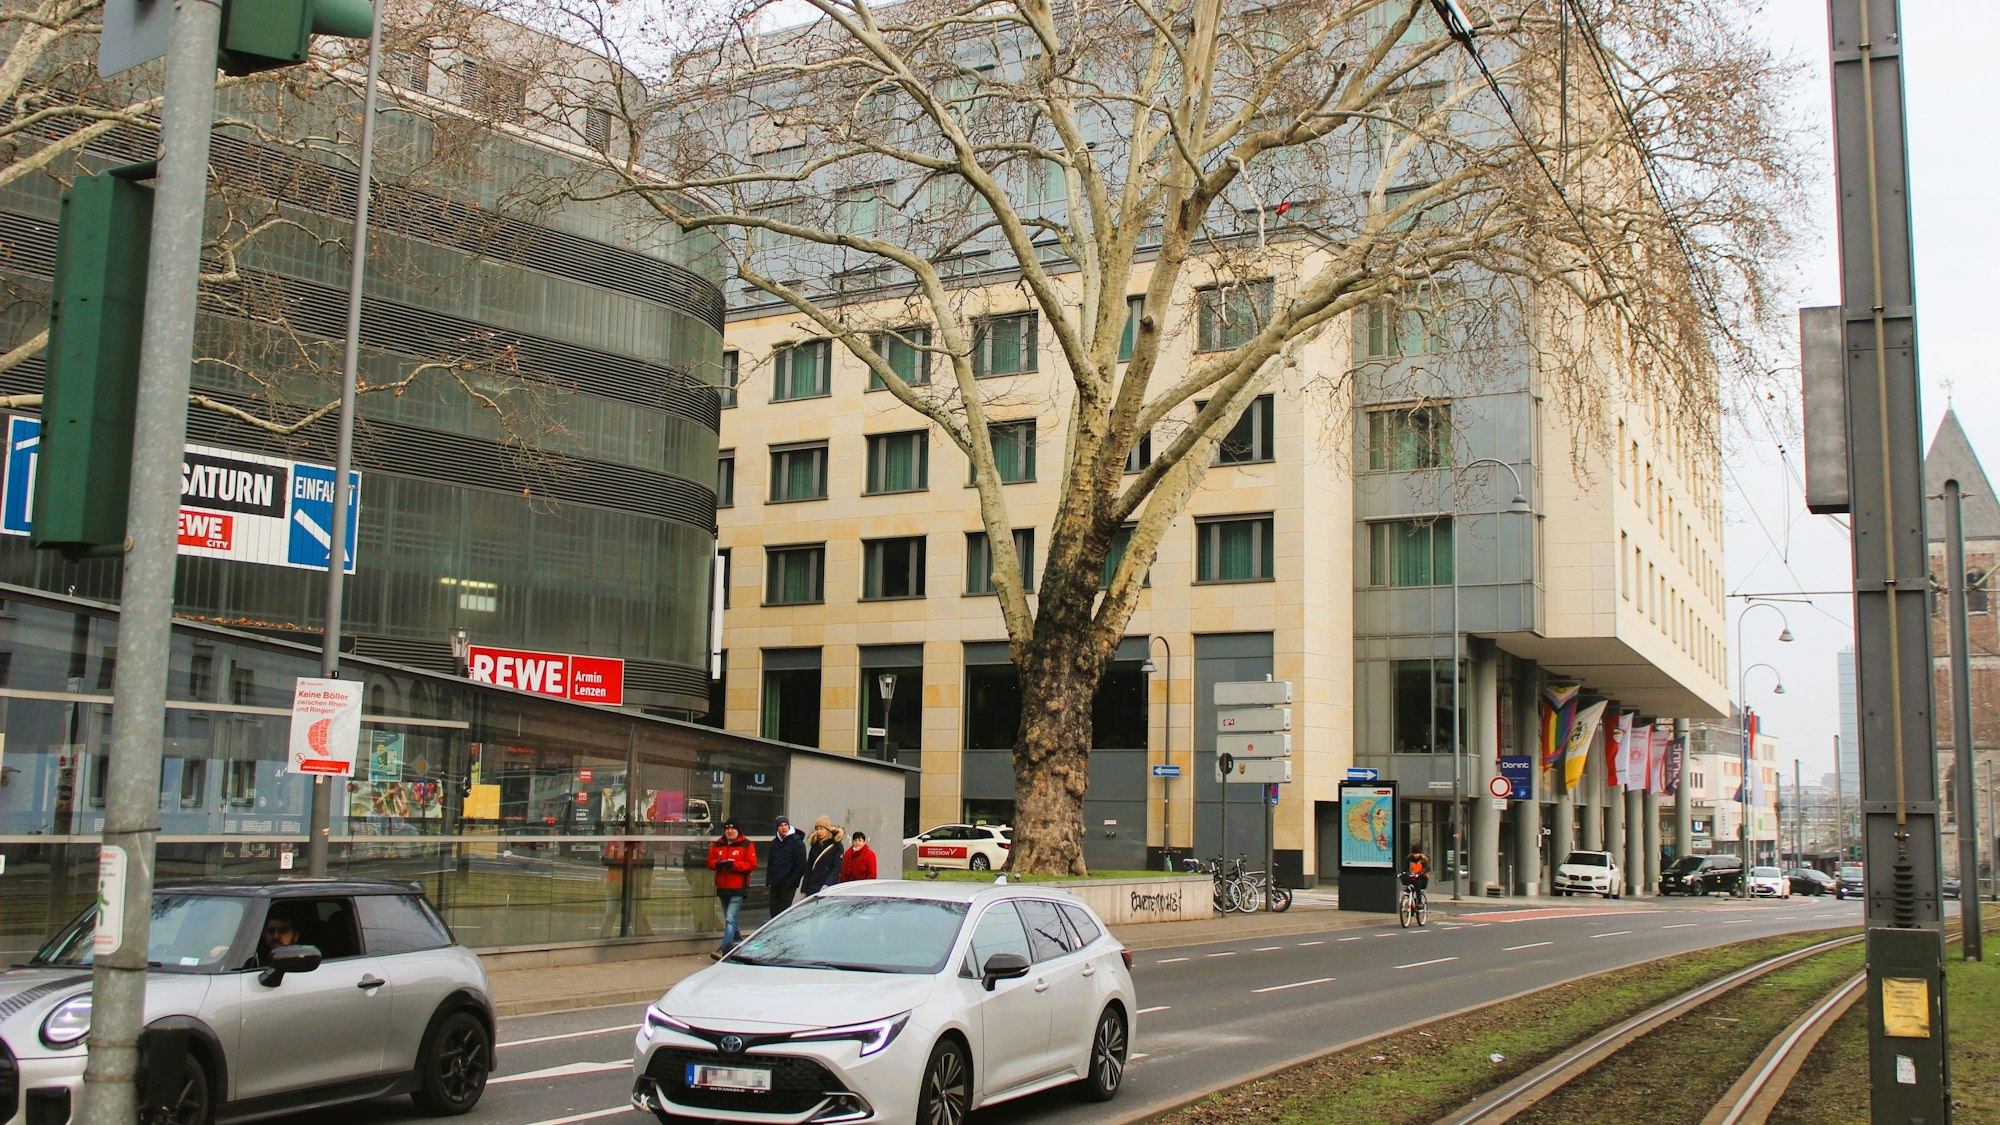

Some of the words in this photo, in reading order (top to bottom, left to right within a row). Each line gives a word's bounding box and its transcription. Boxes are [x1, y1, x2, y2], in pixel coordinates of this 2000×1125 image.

[295, 476, 356, 506] EINFAT
[178, 513, 223, 540] EWE
[206, 539, 229, 549] CITY
[474, 653, 564, 694] REWE
[575, 670, 602, 684] Armin
[298, 690, 322, 699] Keine
[323, 691, 349, 701] Böller
[574, 683, 607, 698] Lenzen
[297, 699, 328, 707] zwischen
[328, 700, 348, 708] Rhein
[309, 707, 336, 715] Ringen!
[1502, 761, 1530, 769] Dorint
[1694, 821, 1704, 831] U
